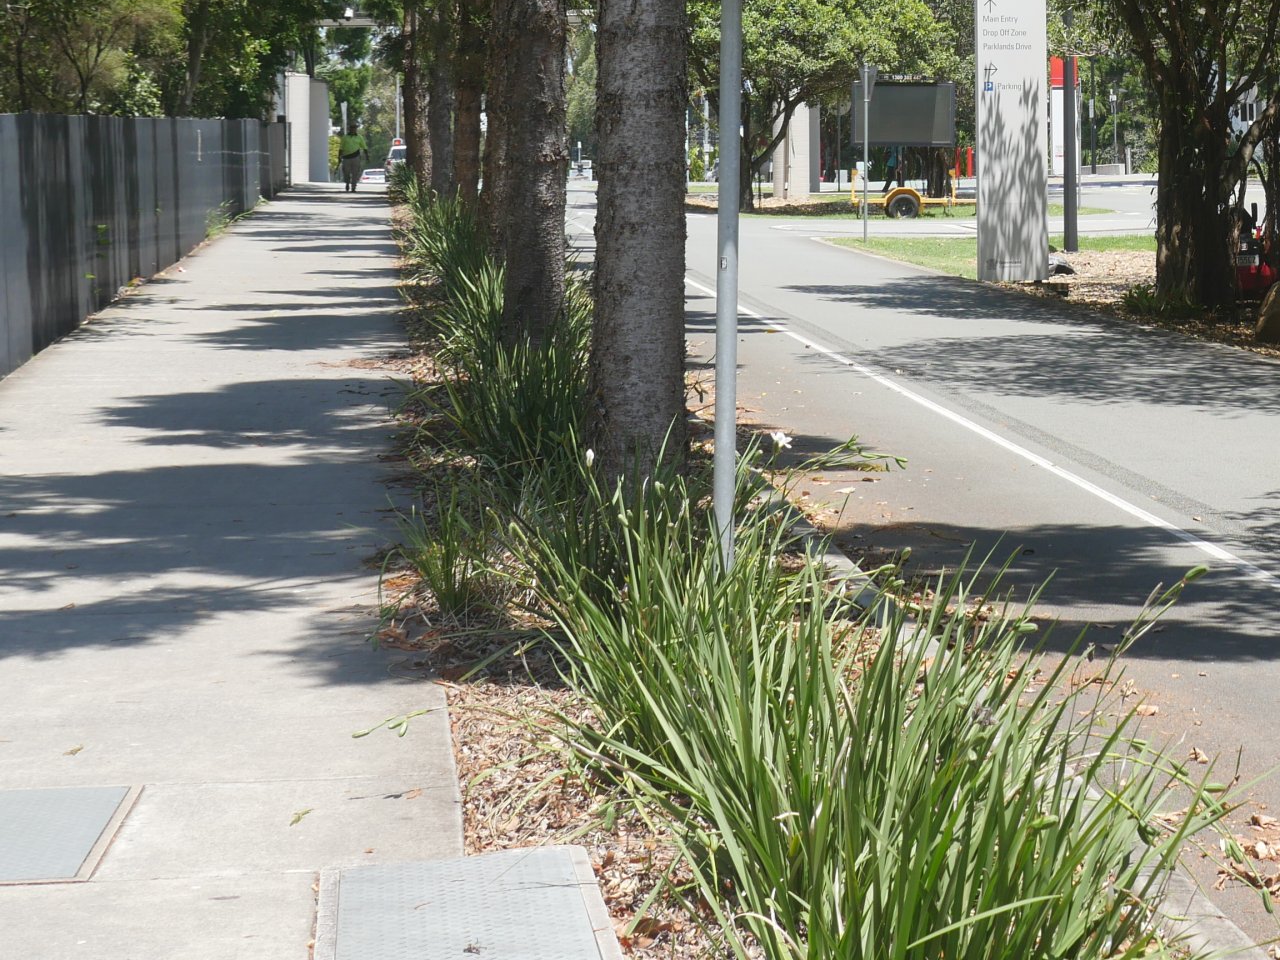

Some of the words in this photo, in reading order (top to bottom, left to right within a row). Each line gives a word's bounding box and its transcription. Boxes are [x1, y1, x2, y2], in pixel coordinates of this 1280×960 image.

[982, 15, 999, 23] Main
[1000, 15, 1018, 24] Entry
[982, 29, 998, 37] Drop
[1010, 29, 1026, 37] Zone
[997, 83, 1022, 91] Parking
